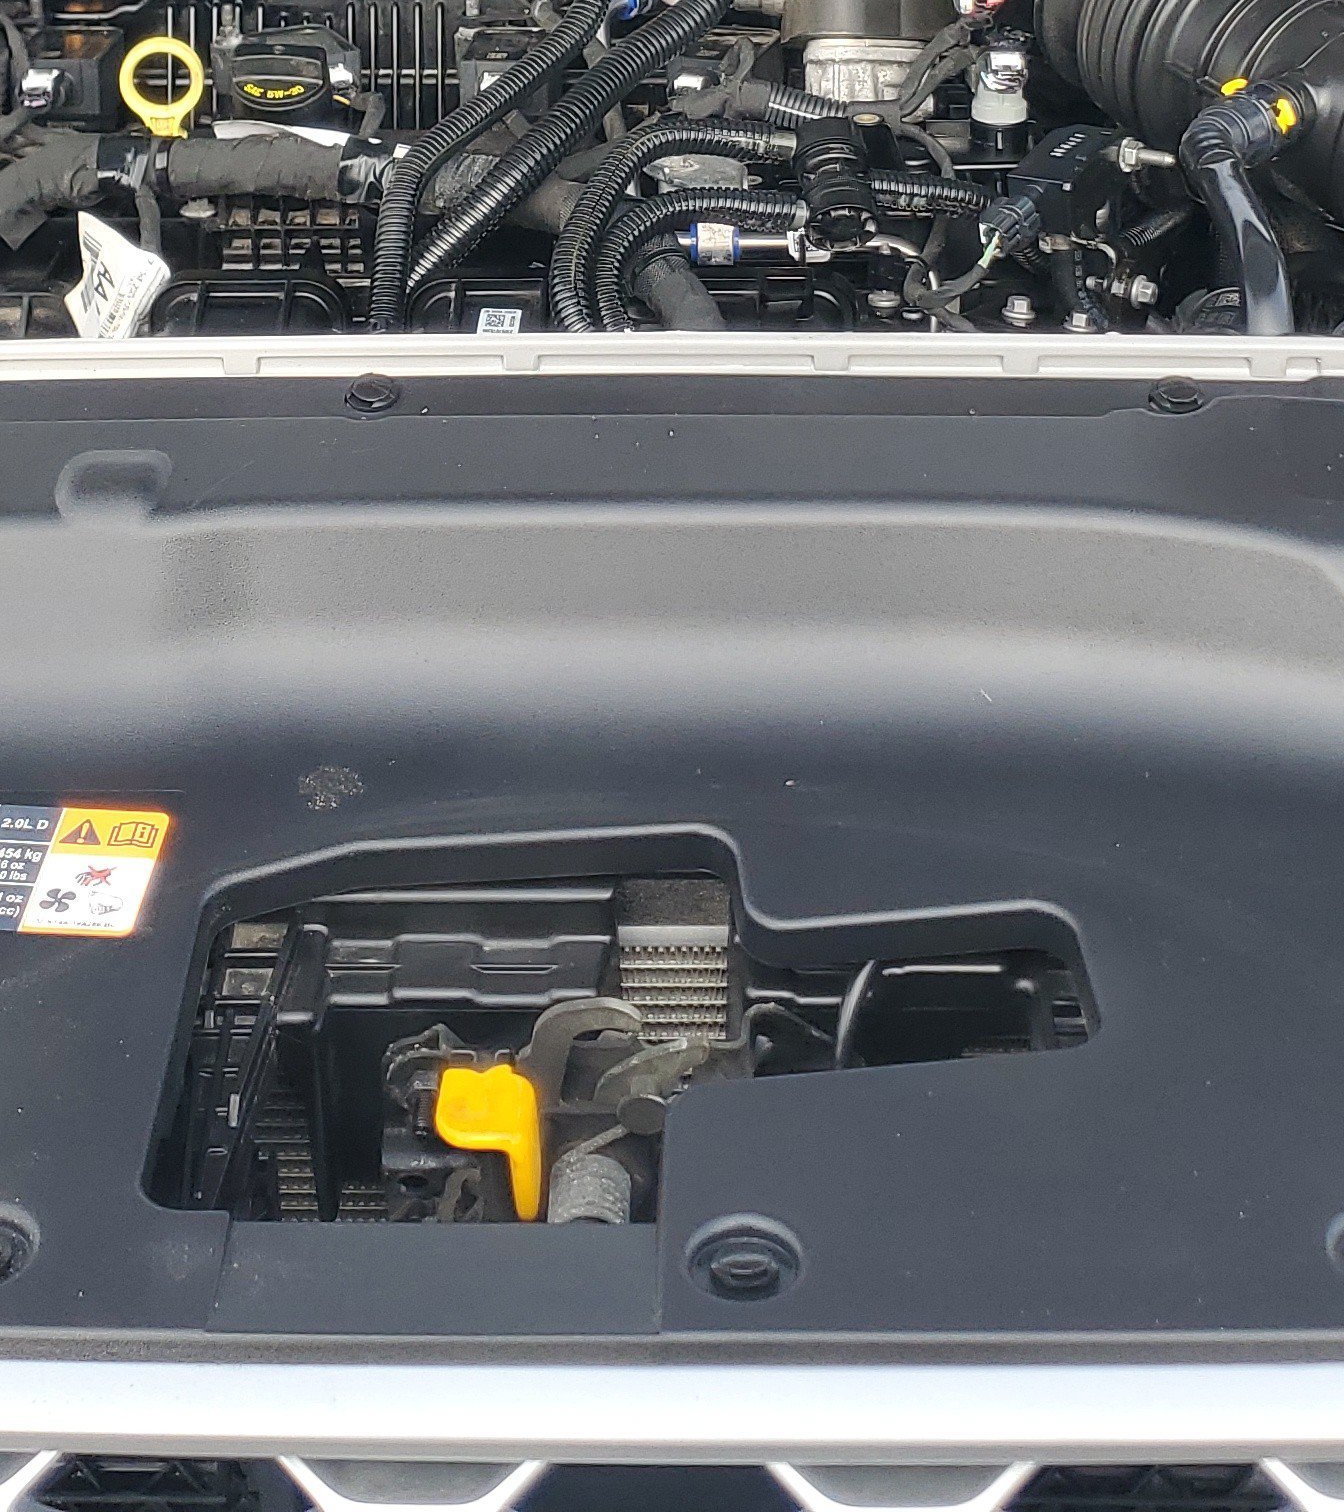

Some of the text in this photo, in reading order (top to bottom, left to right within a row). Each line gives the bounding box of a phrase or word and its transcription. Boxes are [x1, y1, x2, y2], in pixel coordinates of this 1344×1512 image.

[0, 818, 49, 830] 2.0L D
[23, 848, 43, 863] kg
[10, 862, 26, 870] oz
[8, 871, 28, 881] lbs
[5, 893, 24, 903] oz
